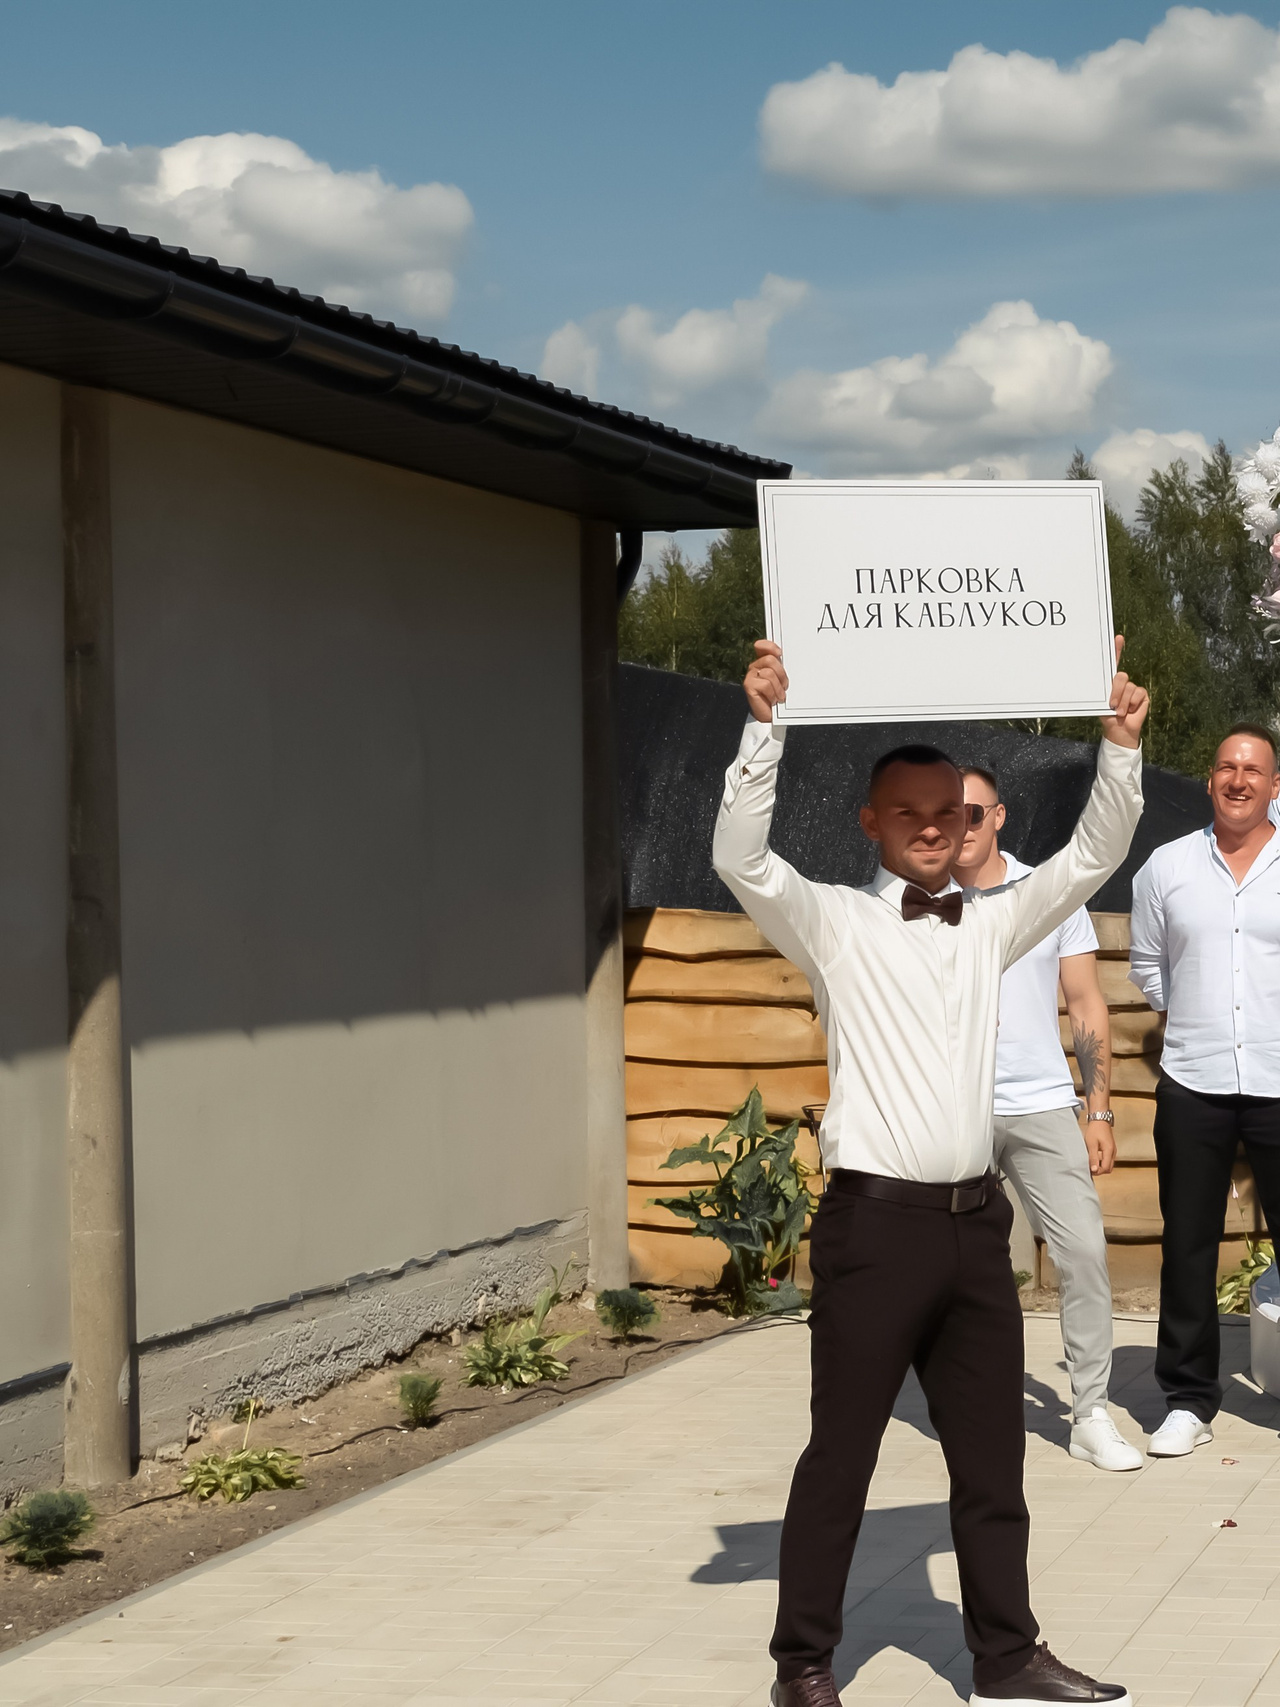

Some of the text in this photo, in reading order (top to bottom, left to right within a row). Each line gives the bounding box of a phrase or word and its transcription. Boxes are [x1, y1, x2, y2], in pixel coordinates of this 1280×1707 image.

[855, 567, 1025, 594] ПАРКОВКА
[817, 600, 1067, 633] ДЛЯ КАБЛУКОВ
